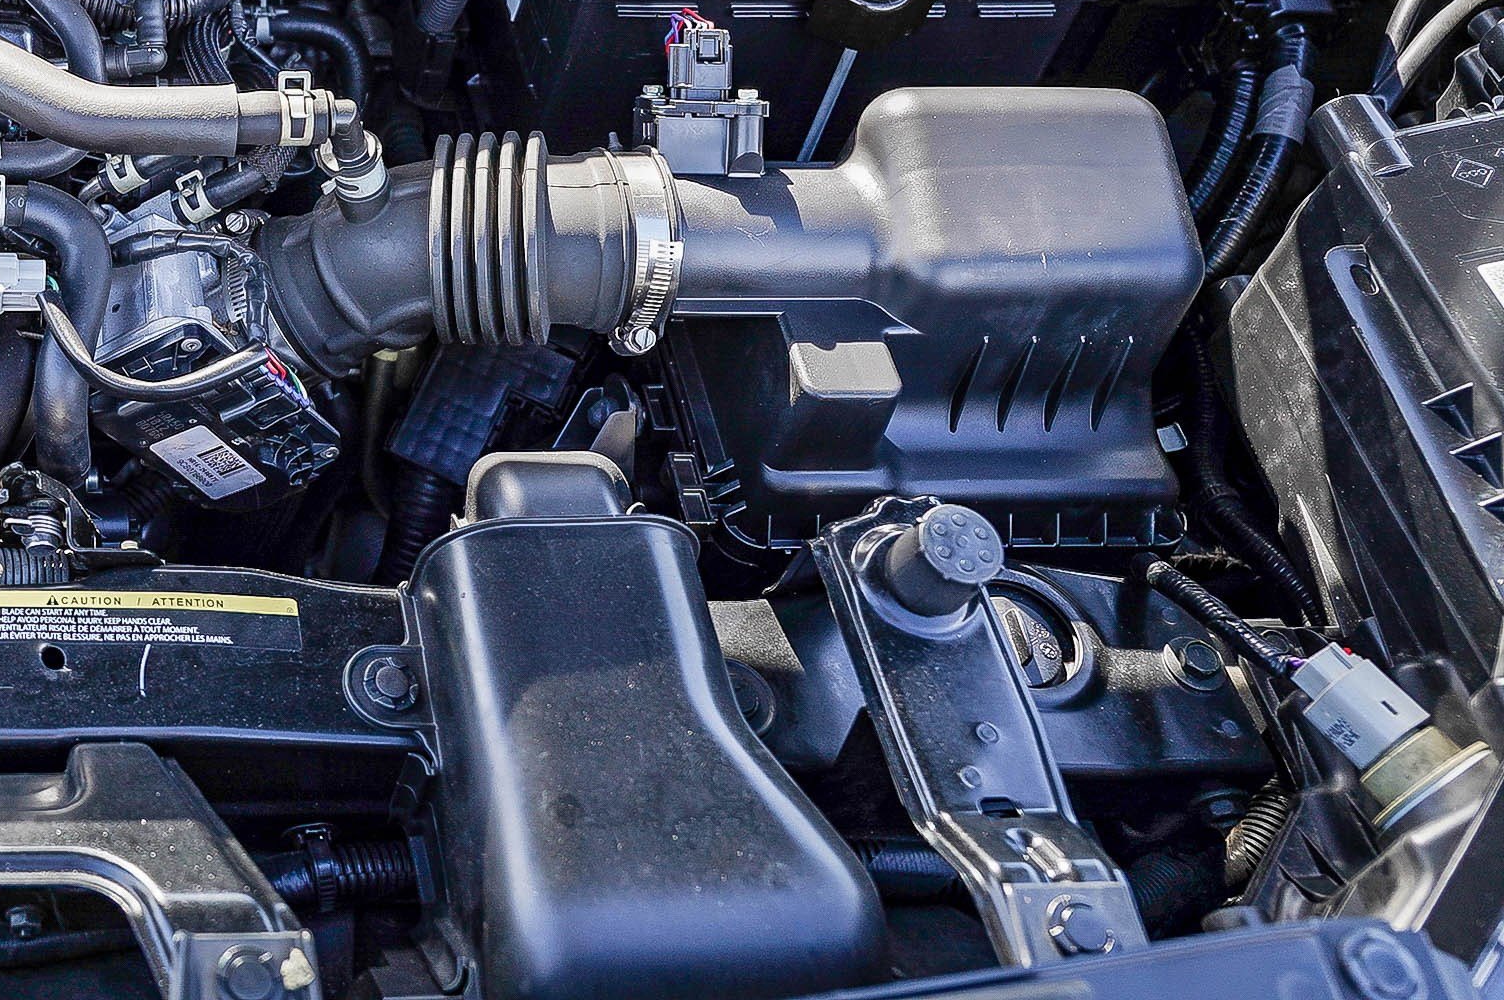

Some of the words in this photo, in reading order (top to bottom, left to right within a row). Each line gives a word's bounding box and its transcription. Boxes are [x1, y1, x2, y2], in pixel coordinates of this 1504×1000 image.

[61, 596, 122, 606] CAUTION
[152, 597, 224, 608] ATTENTION
[1, 608, 25, 616] BLADE
[25, 608, 41, 616] CAN
[41, 608, 63, 616] START
[63, 608, 73, 616] AT
[17, 616, 39, 624] AVOID
[40, 616, 76, 624] PERSONAL
[104, 617, 122, 625] KEEP
[122, 617, 148, 625] HANDS
[49, 624, 77, 632] RISQUE
[89, 624, 132, 633] DÉMARRER
[9, 631, 36, 640] ÉVITER
[36, 632, 62, 640] TOUTE
[144, 634, 191, 642] APPROCHER
[192, 634, 205, 643] LES
